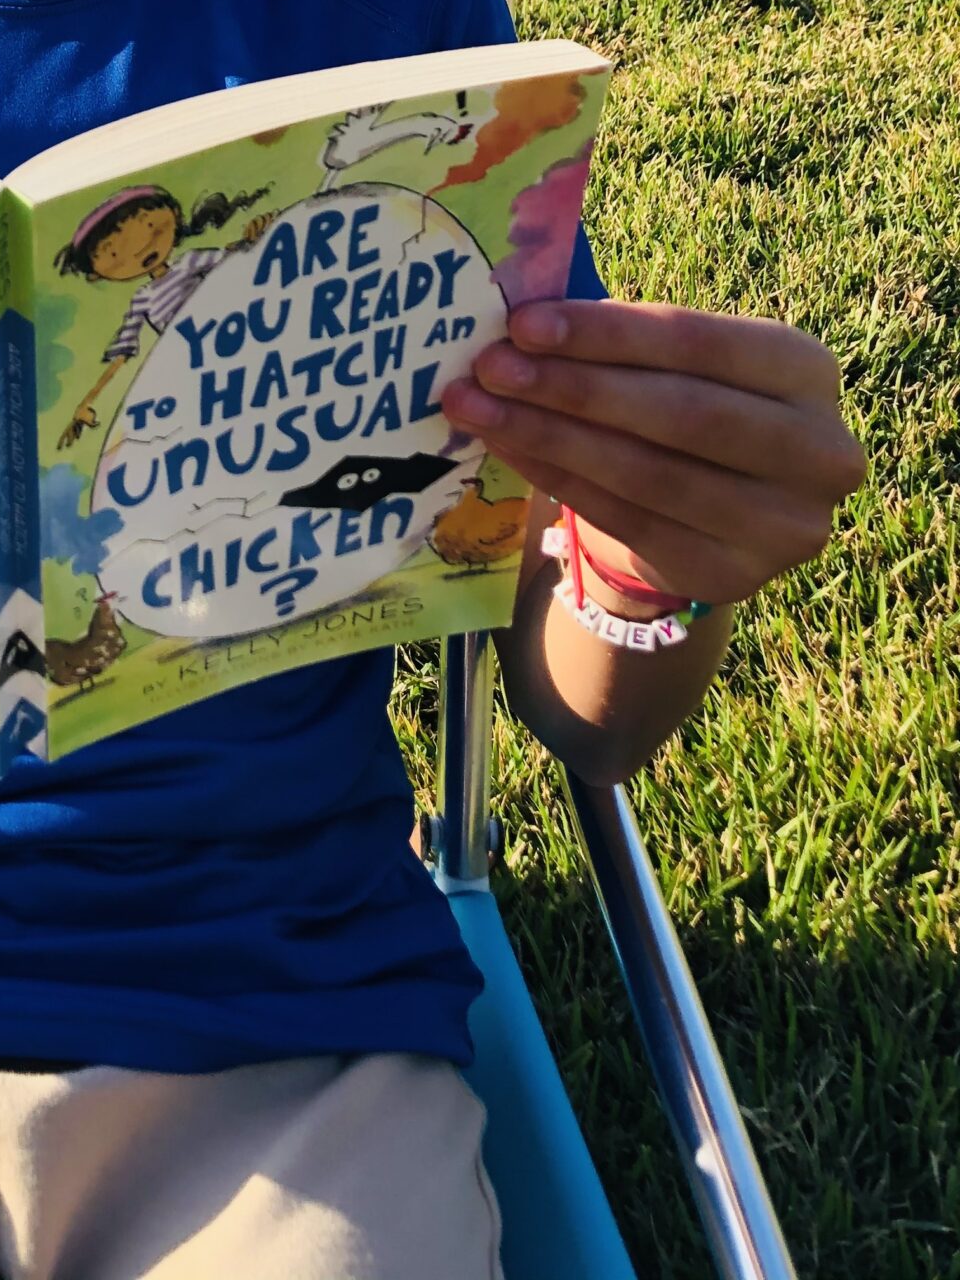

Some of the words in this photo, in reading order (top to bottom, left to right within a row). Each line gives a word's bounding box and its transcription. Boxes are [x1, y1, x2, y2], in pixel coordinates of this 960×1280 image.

[253, 204, 380, 287] ARE
[175, 297, 292, 369] YOU
[309, 248, 471, 340] READY
[126, 396, 177, 431] TO
[200, 324, 407, 426] HATCH
[260, 567, 319, 616] ?
[178, 630, 284, 680] KELLY
[303, 596, 425, 637] JONES
